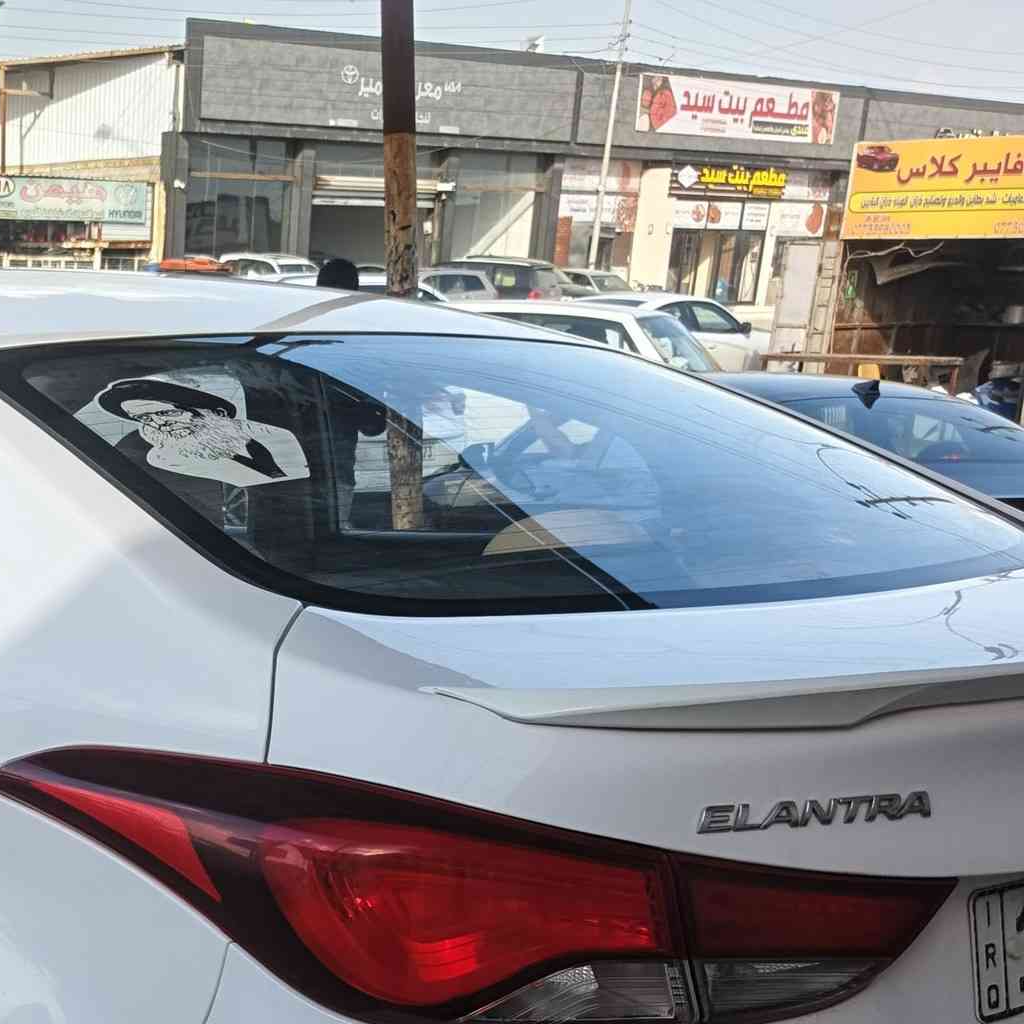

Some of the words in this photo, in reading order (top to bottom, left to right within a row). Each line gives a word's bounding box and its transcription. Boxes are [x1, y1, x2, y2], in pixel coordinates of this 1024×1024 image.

[680, 90, 716, 121] سيد
[718, 90, 747, 124] بيت
[750, 92, 809, 129] مطعم
[699, 166, 728, 188] سيد
[728, 164, 751, 191] بيت
[750, 167, 786, 192] مطعم
[897, 153, 962, 184] كلاس
[697, 791, 931, 833] ELANTRA
